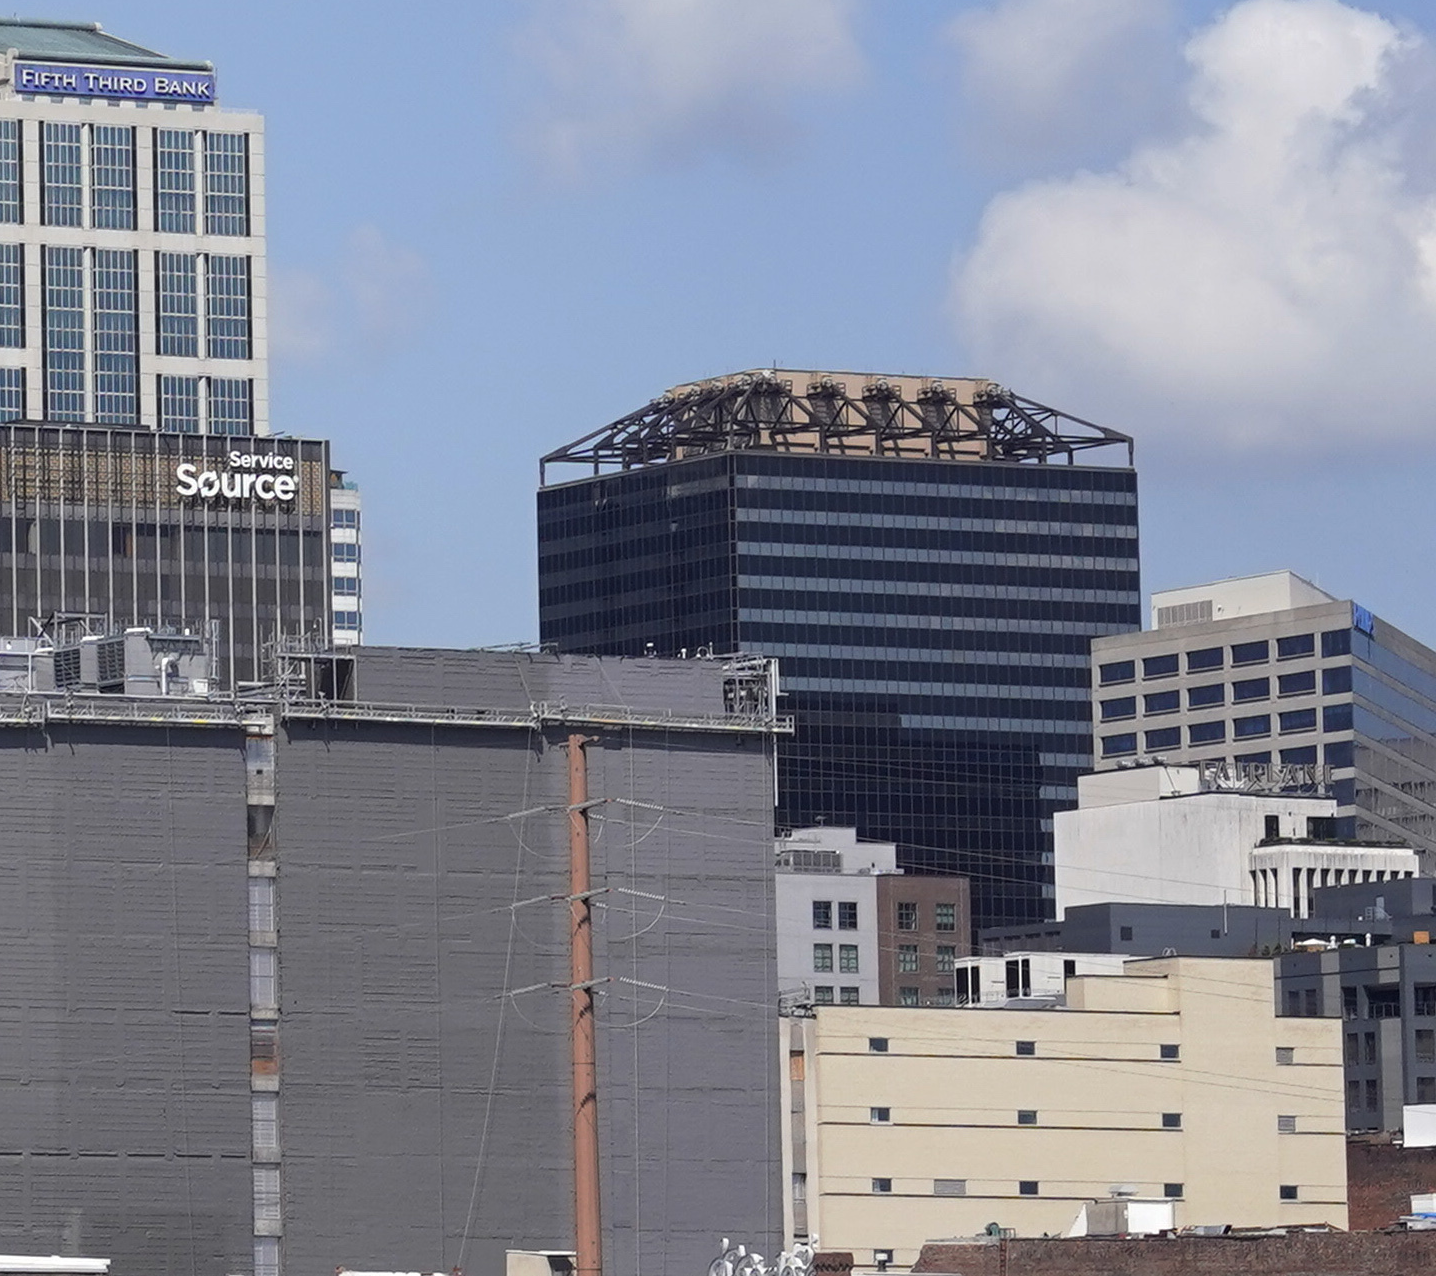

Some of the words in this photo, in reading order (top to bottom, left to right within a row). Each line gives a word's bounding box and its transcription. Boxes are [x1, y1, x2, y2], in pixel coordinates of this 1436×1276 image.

[22, 68, 76, 88] FIFTH
[84, 73, 147, 93] THIRD
[154, 77, 209, 96] BANK
[230, 451, 293, 469] Service
[176, 463, 295, 500] Source
